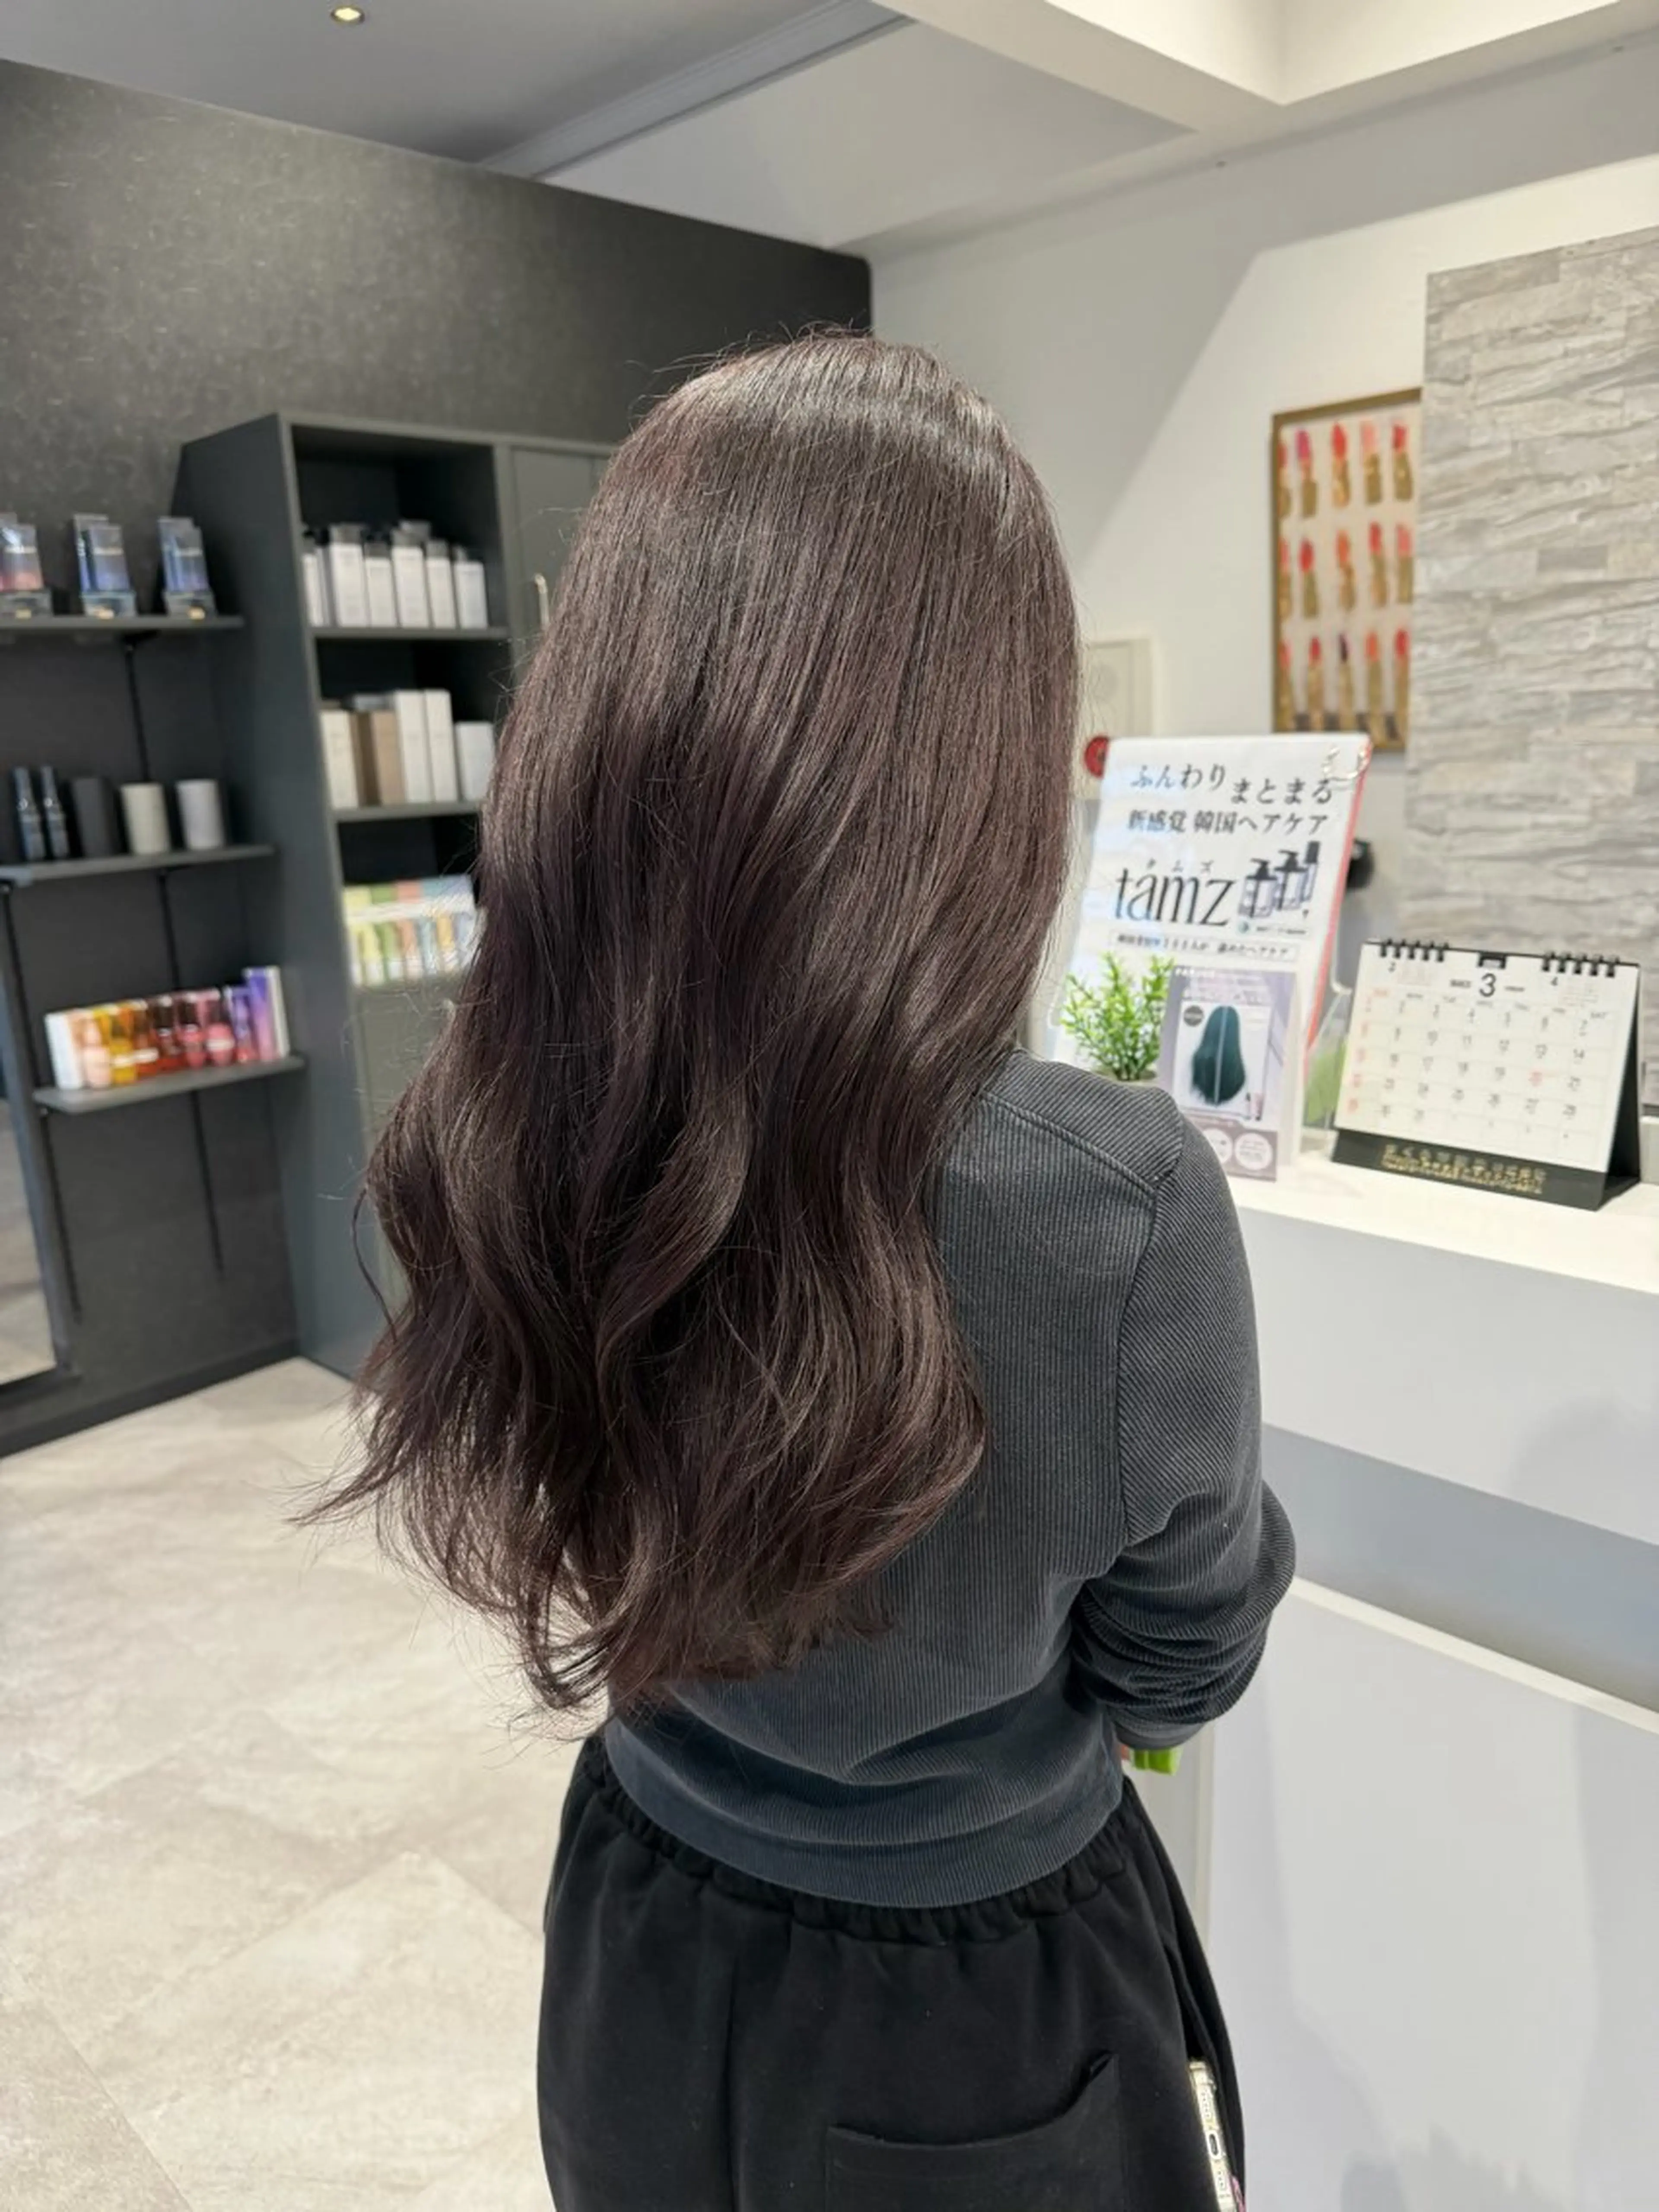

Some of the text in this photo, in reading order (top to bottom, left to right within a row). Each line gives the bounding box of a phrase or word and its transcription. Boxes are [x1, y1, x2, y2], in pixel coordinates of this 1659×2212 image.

[1131, 764, 1332, 804] ふんわり まとまる
[1127, 809, 1328, 835] 新感覚 韓国ヘアケア
[1115, 868, 1236, 927] tamz
[1479, 973, 1497, 998] 3
